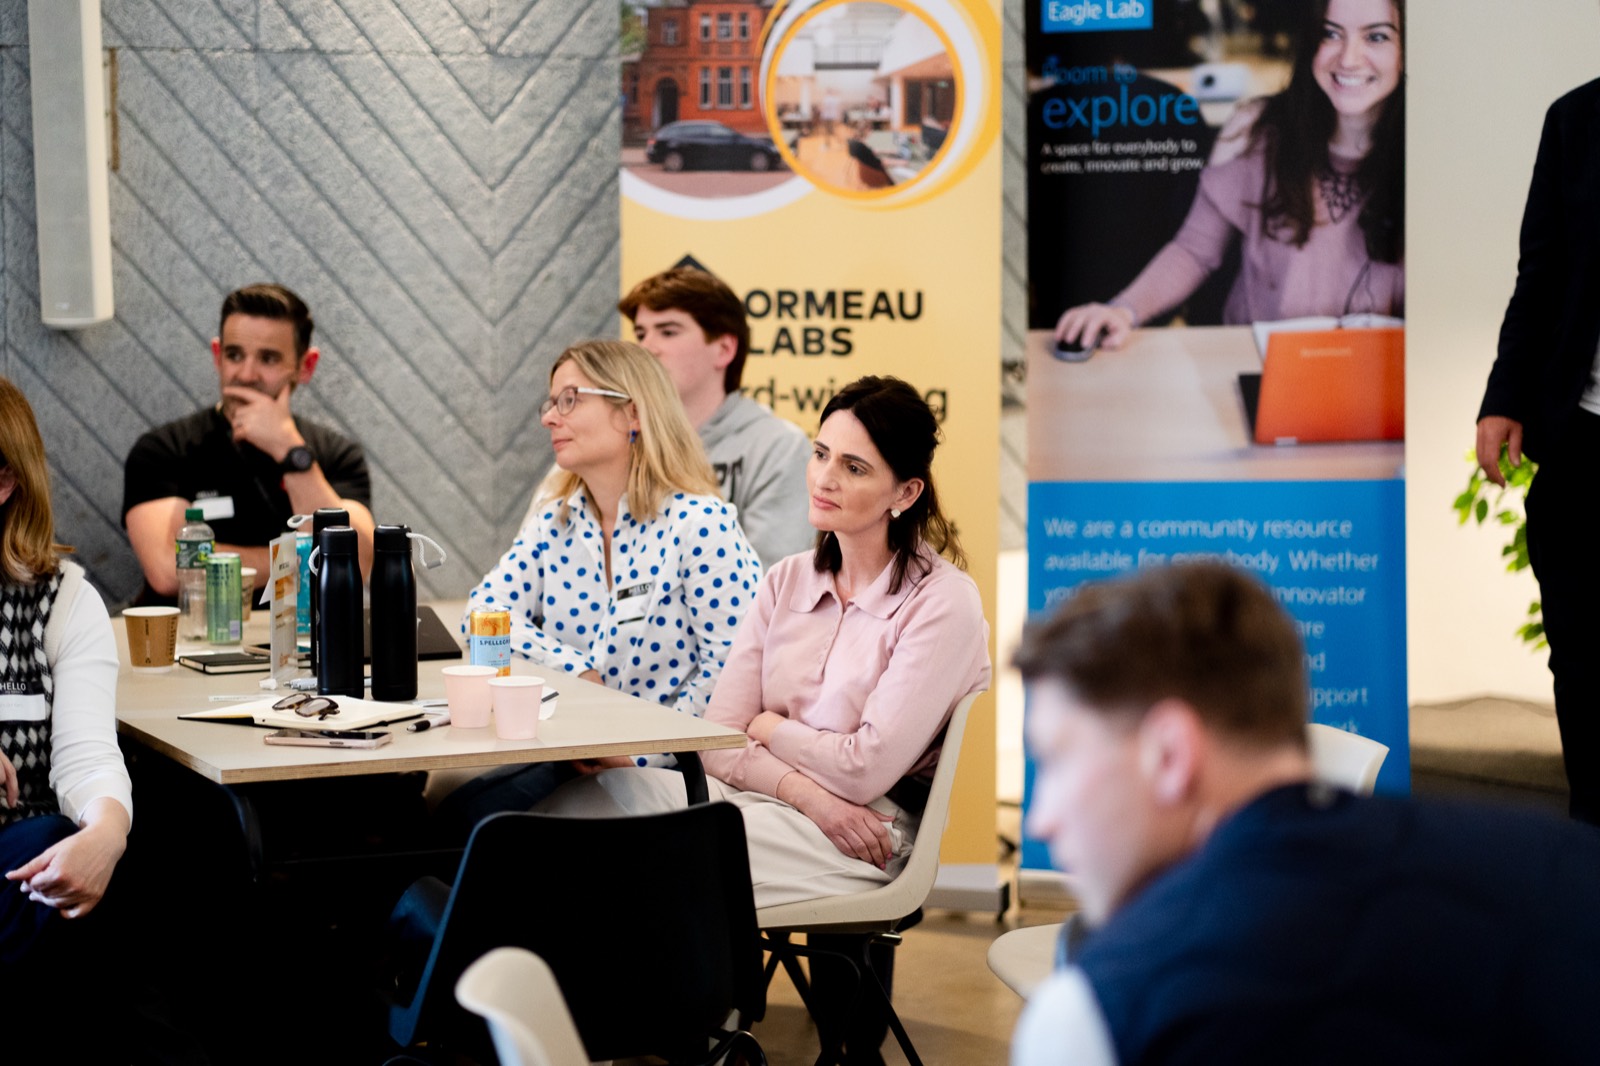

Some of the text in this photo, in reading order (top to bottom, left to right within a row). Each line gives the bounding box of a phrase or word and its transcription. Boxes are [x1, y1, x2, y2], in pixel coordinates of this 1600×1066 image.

[1048, 0, 1145, 26] Eagle Lab
[1113, 63, 1138, 84] to
[1042, 83, 1199, 139] explore
[1041, 139, 1197, 158] A space for everybody to
[1085, 158, 1140, 172] innovate
[1141, 155, 1168, 171] and
[744, 289, 923, 320] ORMEAU
[1044, 517, 1353, 543] We are a community resource
[1044, 550, 1133, 571] available
[1288, 550, 1379, 572] Whether
[1309, 686, 1368, 708] pport
